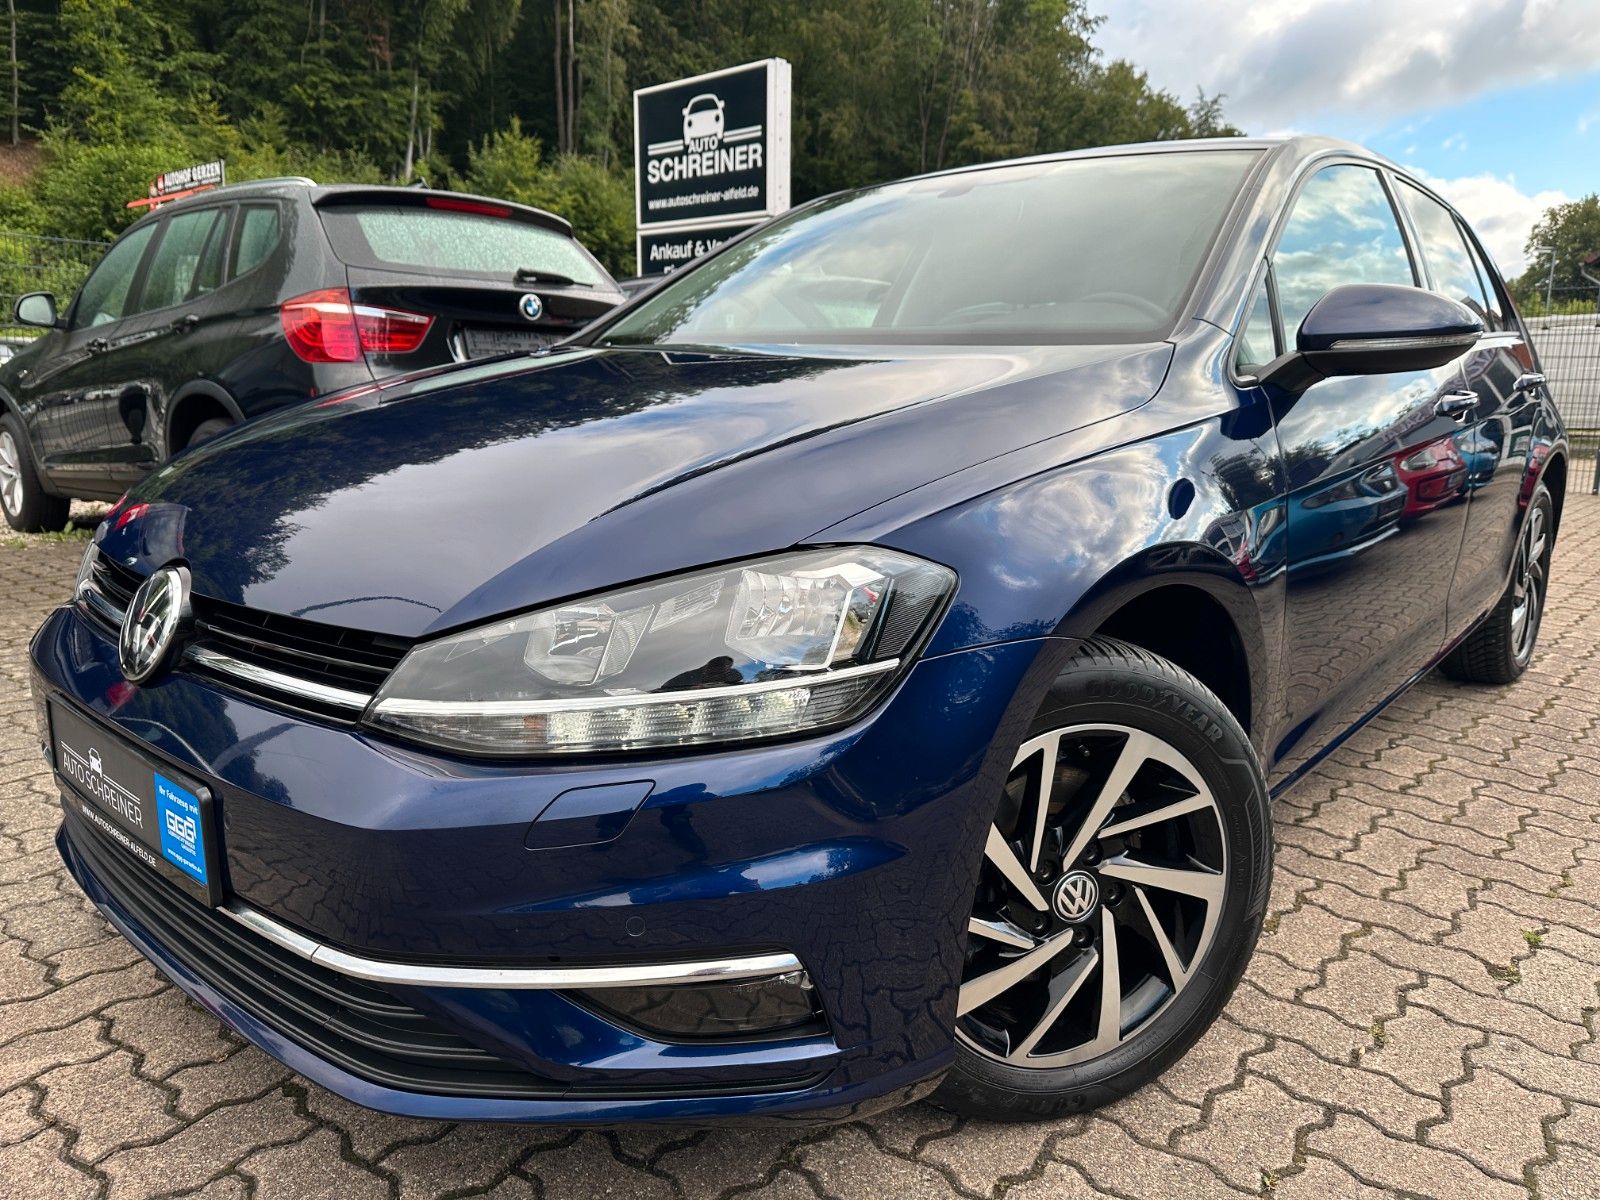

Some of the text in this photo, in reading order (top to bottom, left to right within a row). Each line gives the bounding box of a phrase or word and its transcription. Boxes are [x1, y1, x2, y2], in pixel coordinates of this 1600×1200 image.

[688, 137, 718, 154] AUTO
[647, 143, 762, 183] SCHREINER
[648, 185, 759, 210] www.autoschreiner-alfeld.de
[650, 240, 693, 261] Ankauf
[695, 241, 705, 257] &
[63, 752, 143, 829] AUTO SCHREINER
